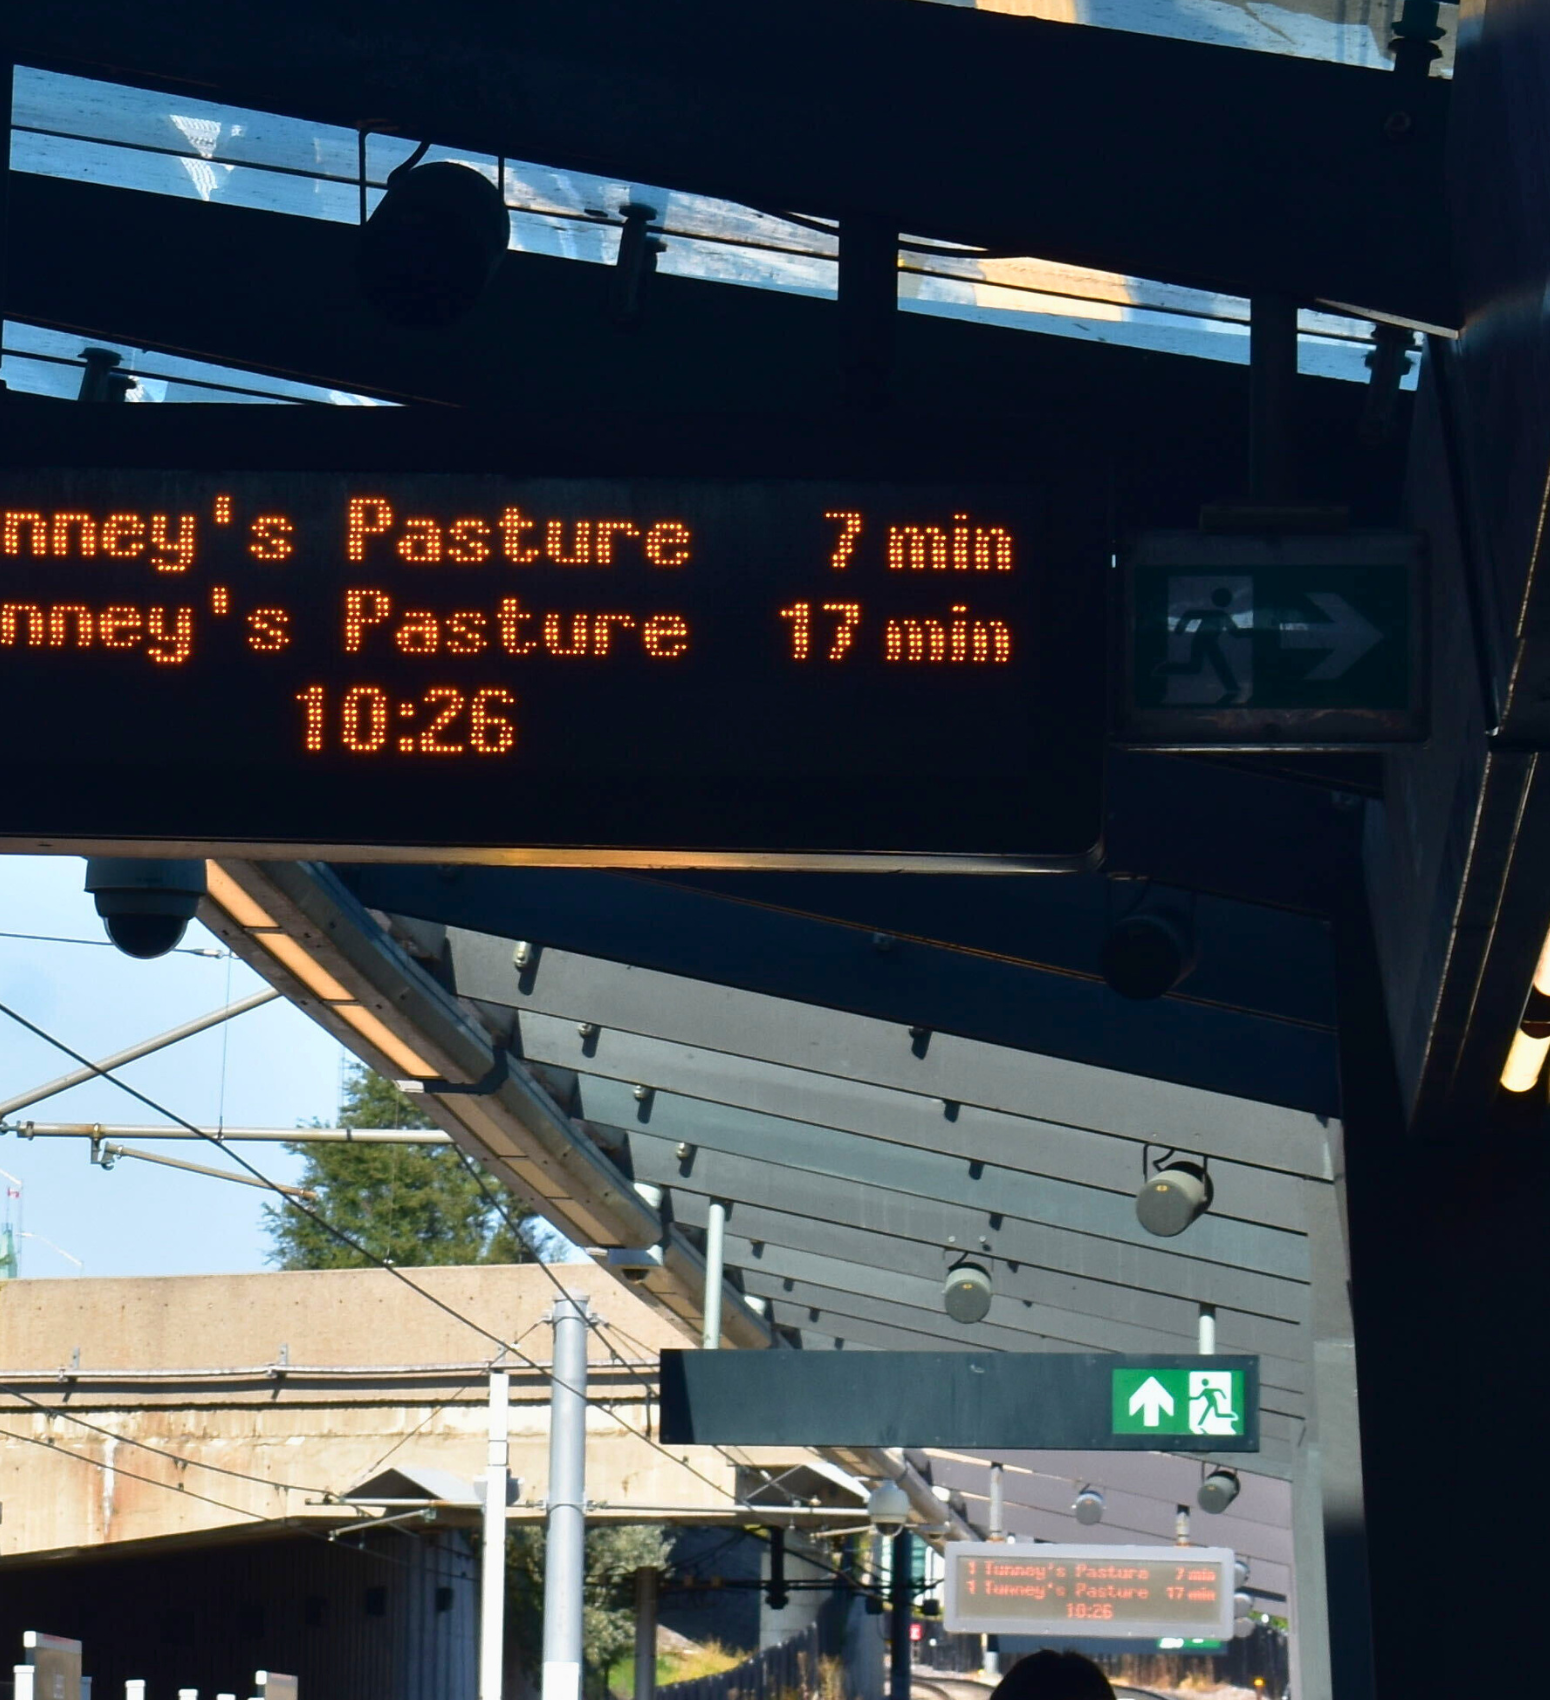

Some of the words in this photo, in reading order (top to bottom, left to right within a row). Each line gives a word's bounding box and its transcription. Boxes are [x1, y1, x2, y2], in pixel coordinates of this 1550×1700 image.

[347, 497, 691, 566] Pasture
[825, 512, 862, 569] 7
[887, 513, 1013, 571] min
[344, 589, 689, 657] Pasture
[779, 601, 860, 660] 17
[885, 604, 1012, 663] min
[295, 685, 515, 754] 10:26
[967, 1561, 977, 1576] 1
[984, 1561, 1066, 1580] Tunney's
[1075, 1564, 1150, 1581] Pasture
[1175, 1567, 1185, 1582] 7
[1188, 1567, 1217, 1582] min
[967, 1580, 977, 1595] 1
[984, 1580, 1066, 1600] Tunney's
[1075, 1582, 1150, 1600] Pasture
[1167, 1586, 1186, 1601] 17
[1188, 1587, 1217, 1602] min
[1066, 1602, 1114, 1620] 10:26
